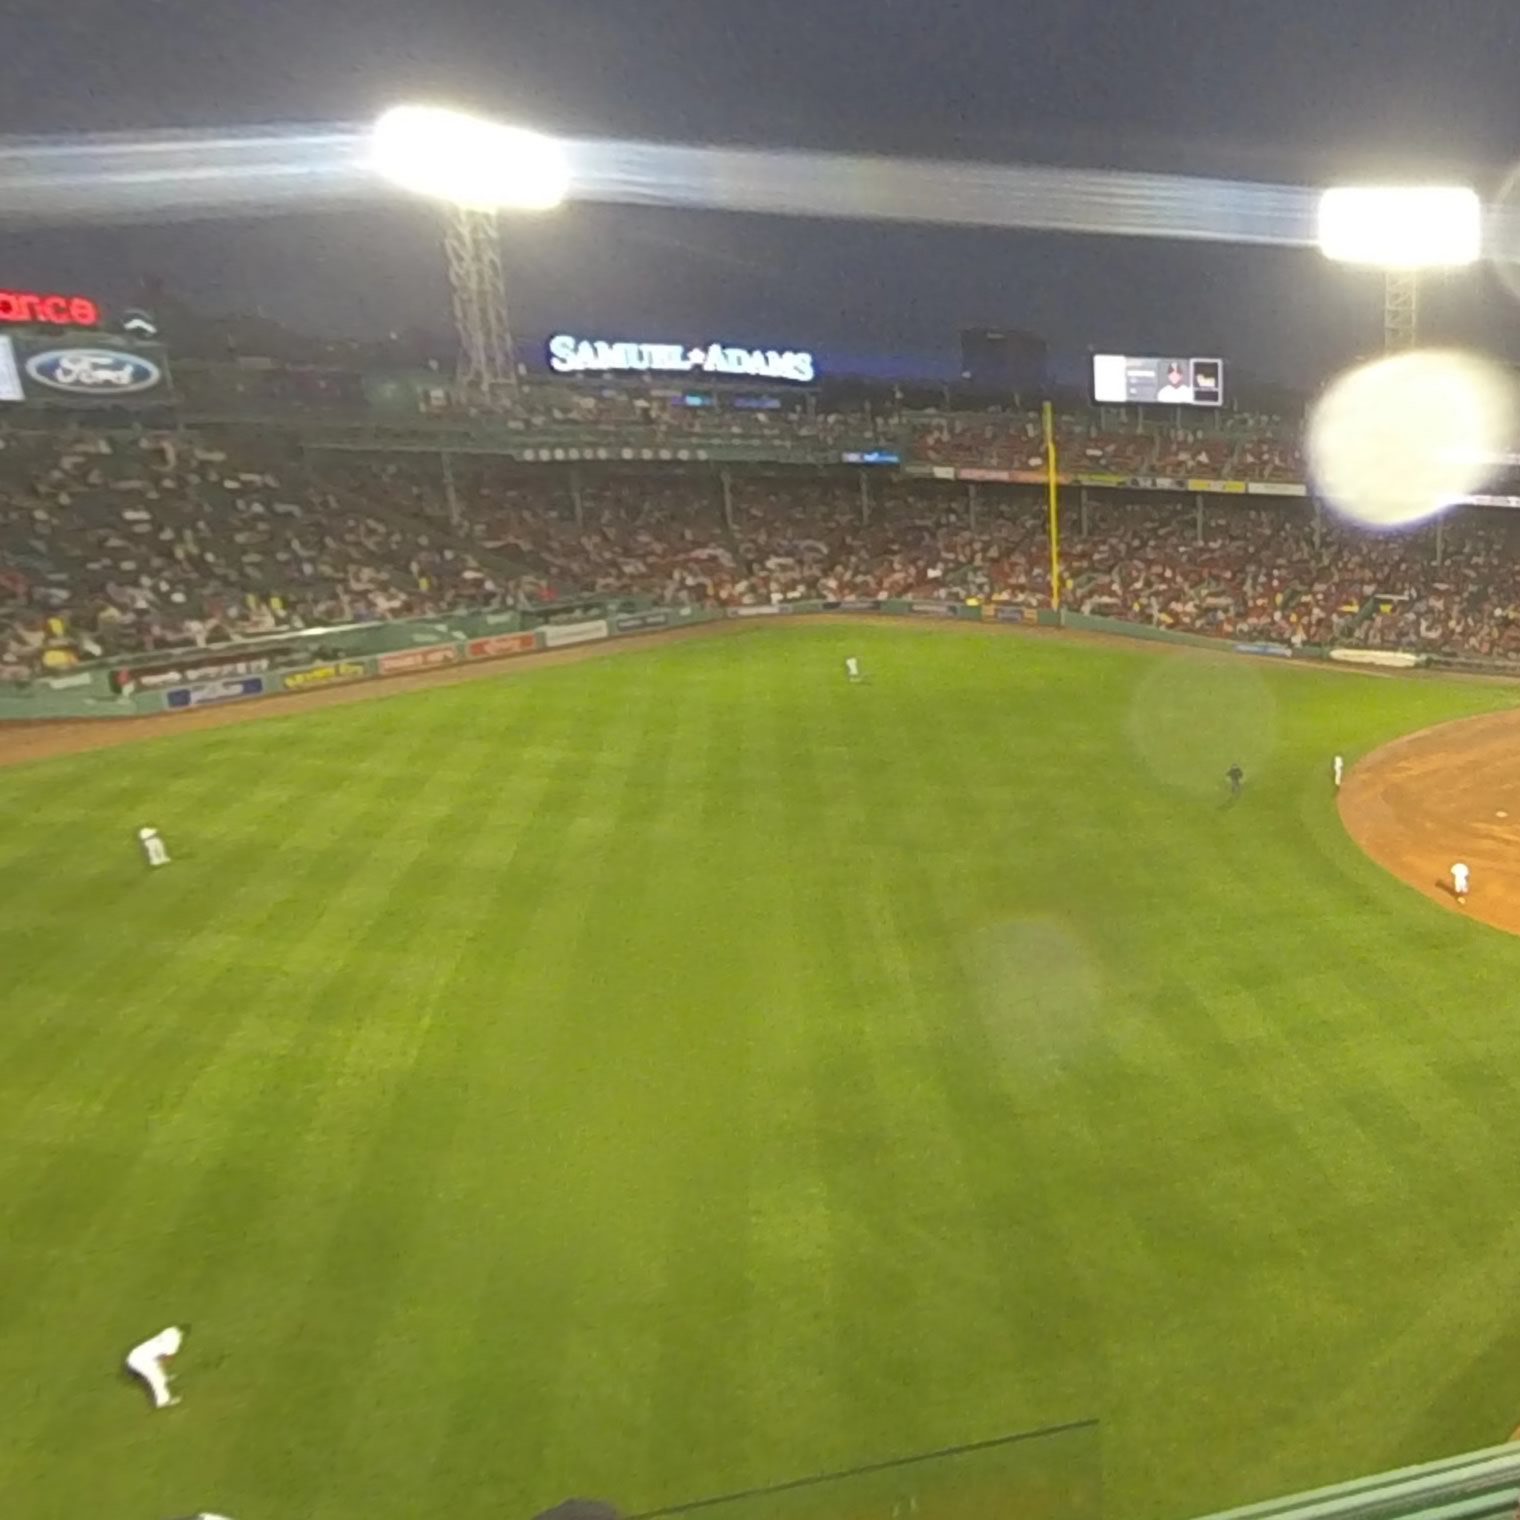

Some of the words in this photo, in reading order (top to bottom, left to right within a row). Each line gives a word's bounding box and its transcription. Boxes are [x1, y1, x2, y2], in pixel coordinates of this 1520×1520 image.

[55, 354, 134, 384] Ford
[549, 335, 691, 372] SAMUEL
[703, 343, 814, 381] ADAMS
